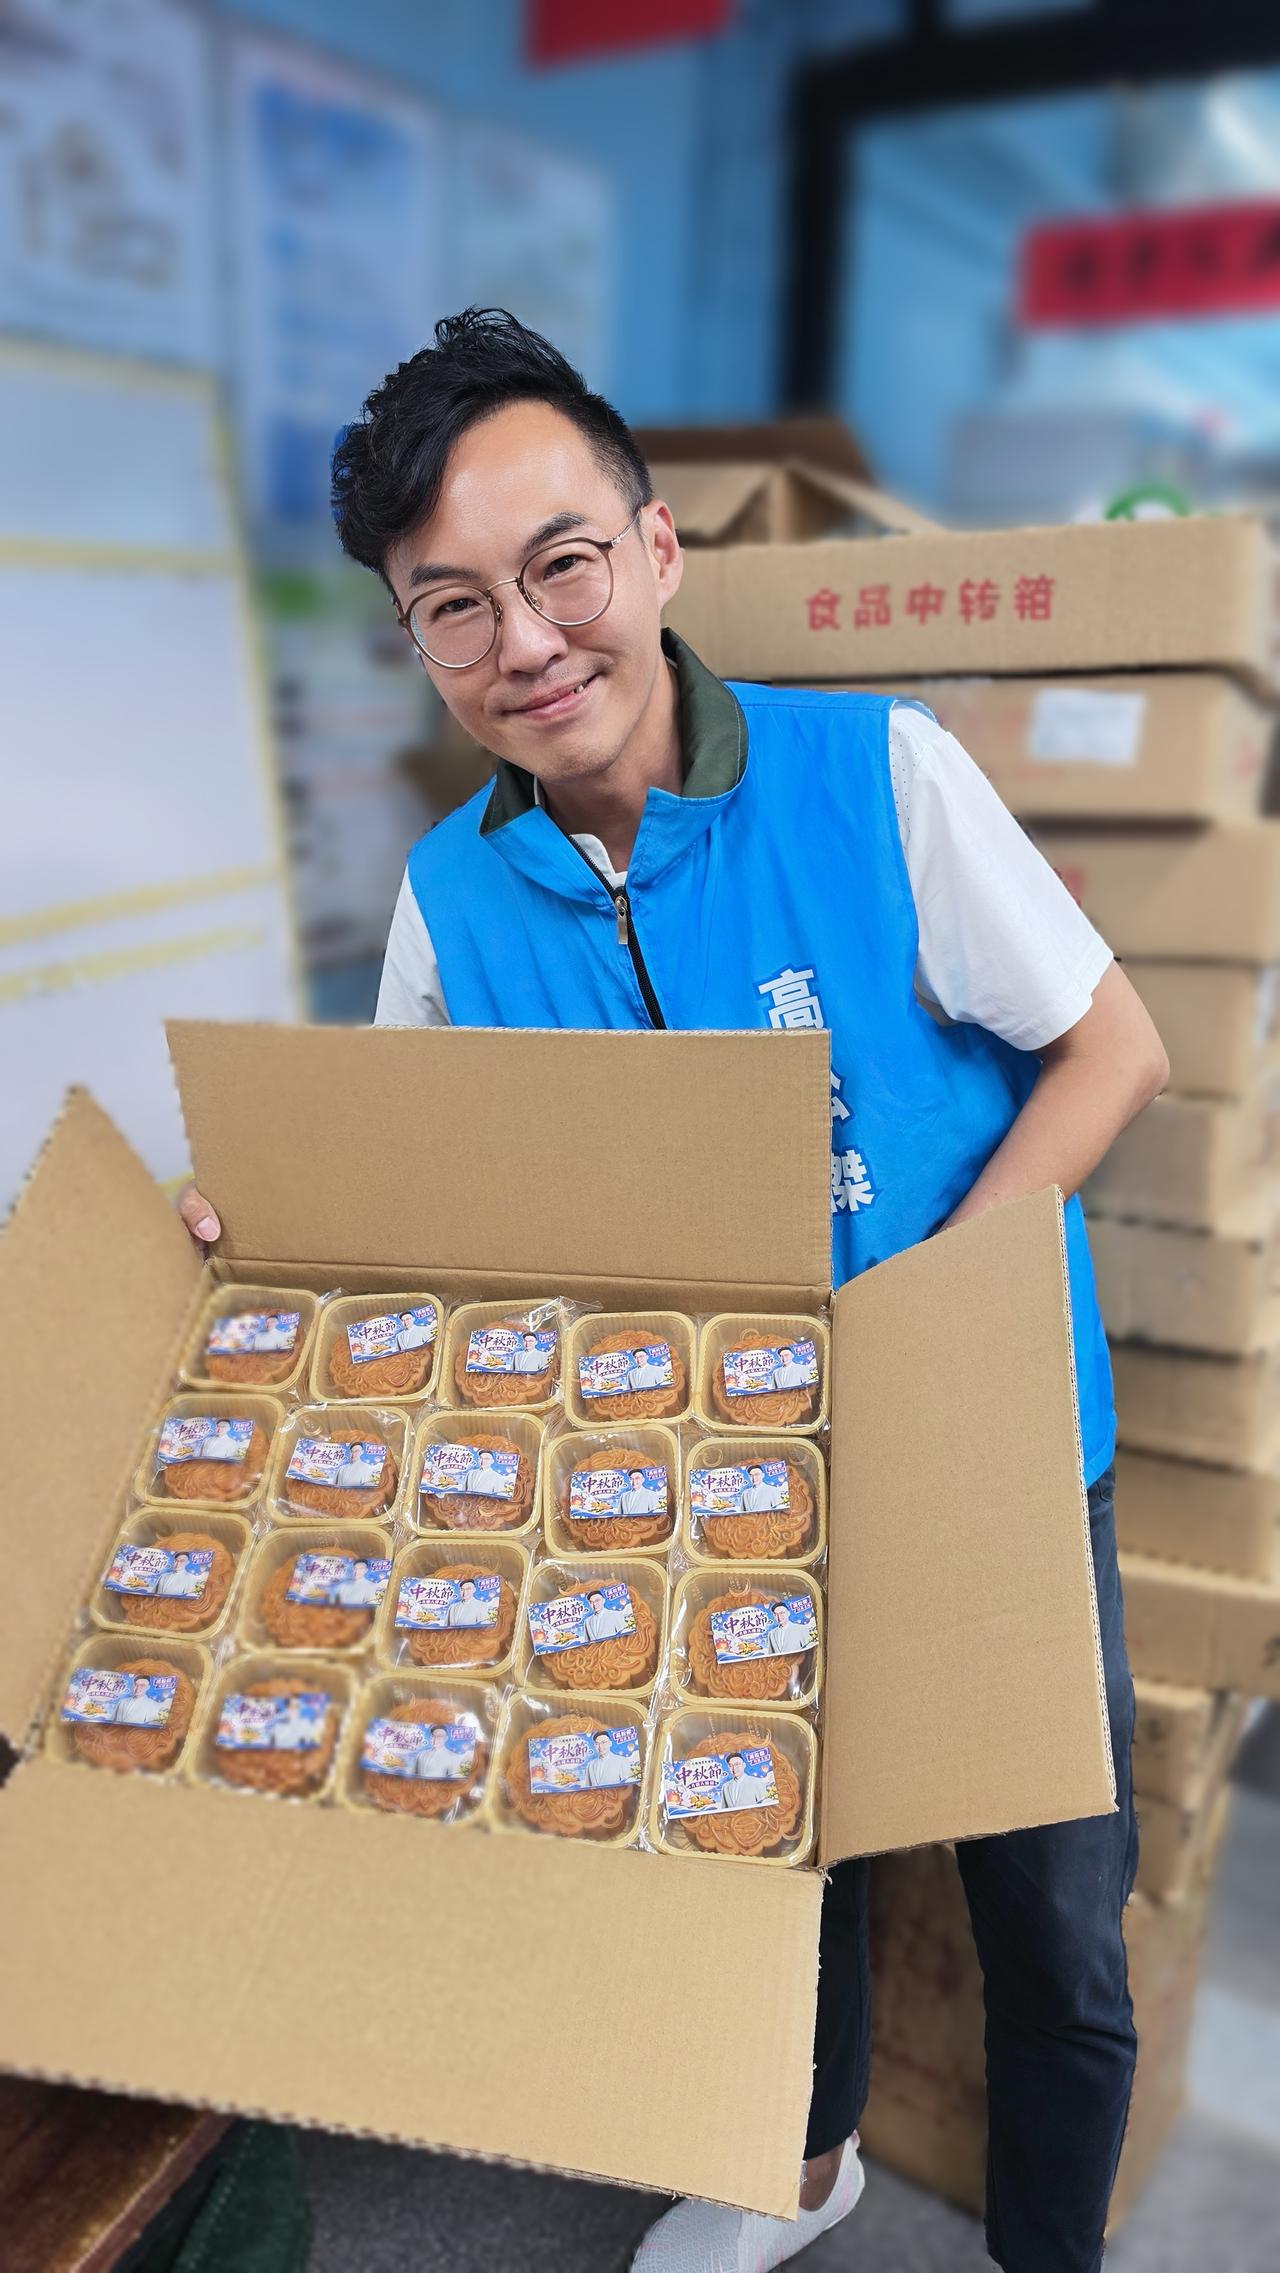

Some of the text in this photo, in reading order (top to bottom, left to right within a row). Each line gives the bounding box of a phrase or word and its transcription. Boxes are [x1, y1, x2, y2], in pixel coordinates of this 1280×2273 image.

[806, 575, 1055, 630] 食品中转箱
[359, 1322, 396, 1339] 中秋節
[479, 1333, 518, 1348] 中秋節
[589, 1357, 629, 1374] 中秋節
[735, 1355, 774, 1372] 中秋節
[174, 1422, 210, 1437] 中秋節
[306, 1444, 345, 1461] 中秋節
[433, 1450, 473, 1467] 中秋節
[582, 1476, 623, 1493] 中秋節
[701, 1474, 743, 1491] 中秋節
[126, 1551, 167, 1568] 中秋節
[411, 1585, 454, 1602] 中秋節
[540, 1603, 583, 1624] 中秋節
[723, 1614, 768, 1634] 中秋節
[81, 1675, 126, 1691] 中秋節
[542, 1741, 589, 1759] 中秋節
[676, 1765, 722, 1785] 中秋節
